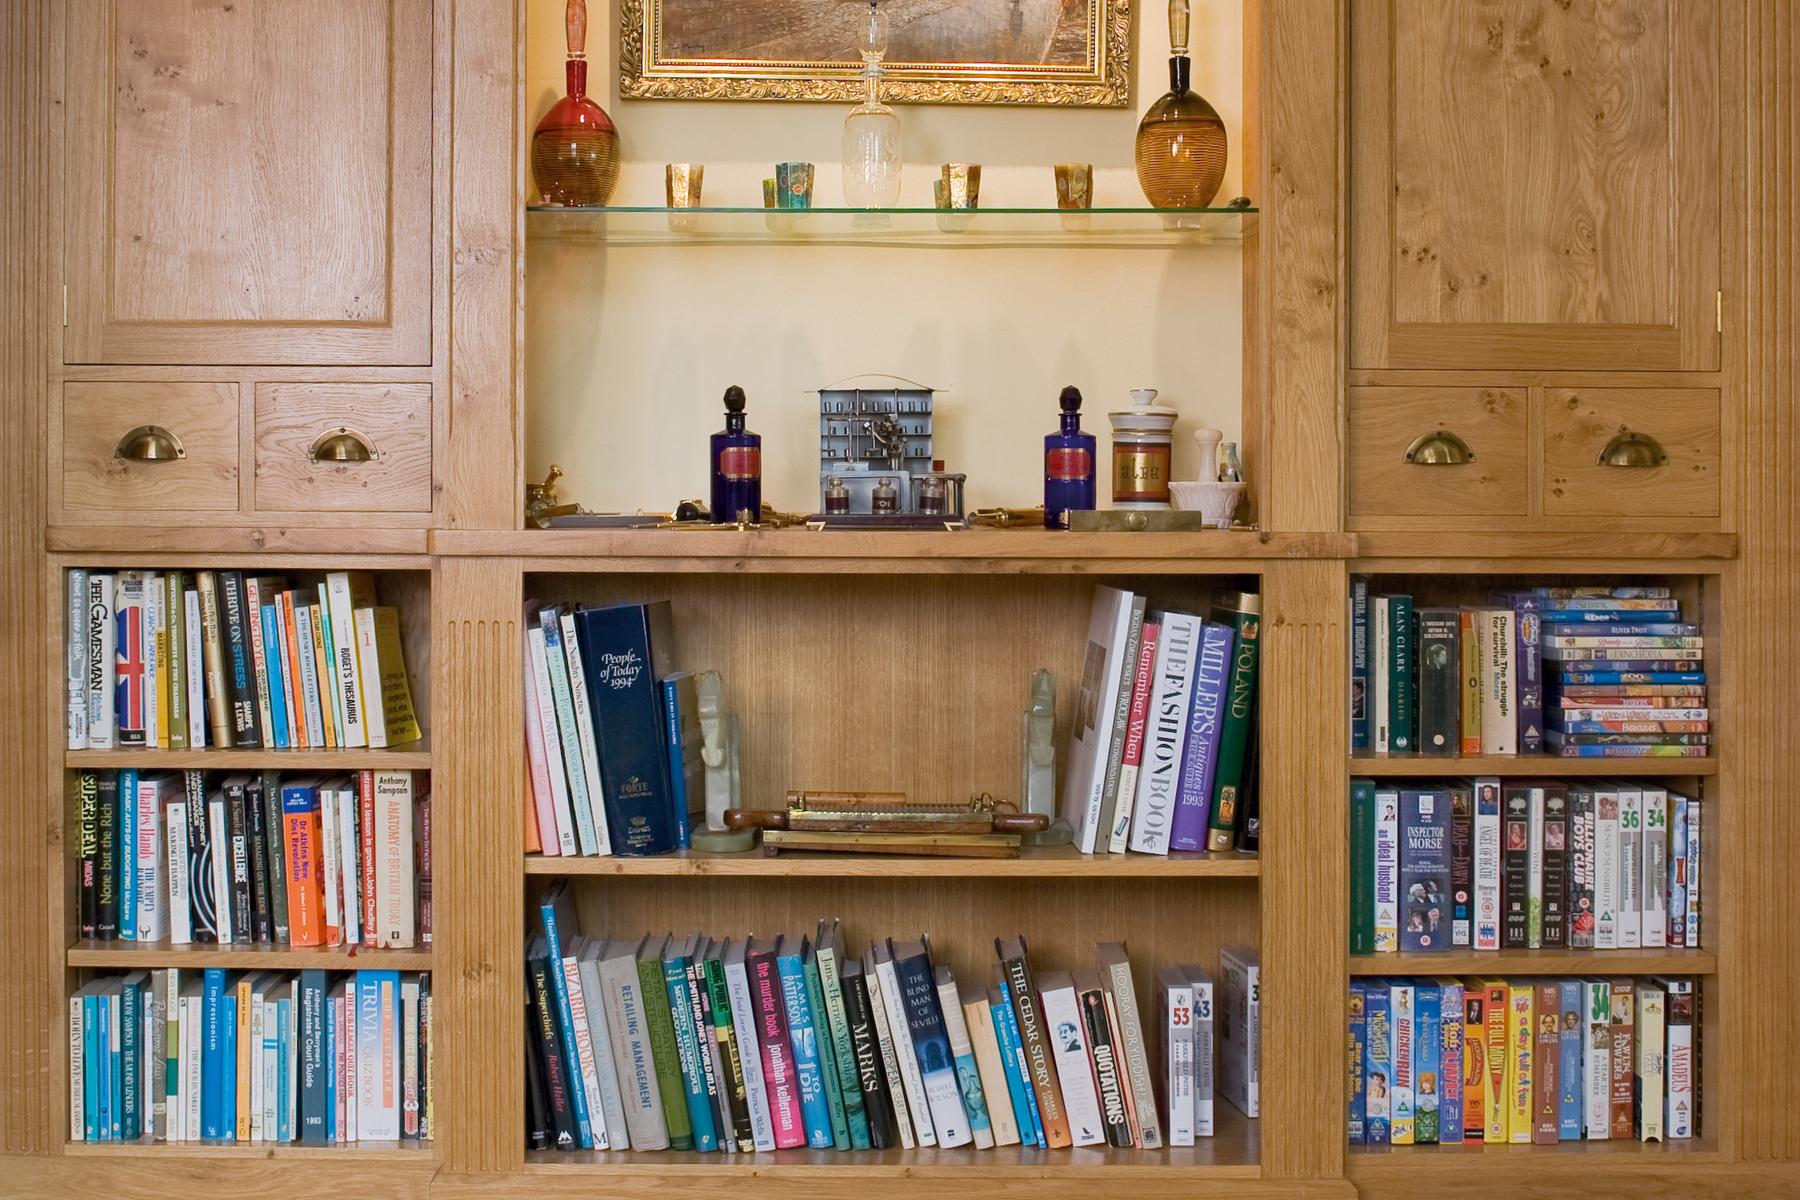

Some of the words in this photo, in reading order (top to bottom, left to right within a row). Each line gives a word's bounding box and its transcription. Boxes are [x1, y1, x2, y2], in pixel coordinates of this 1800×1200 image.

[91, 580, 102, 603] THE
[226, 578, 238, 624] THRIVE
[249, 584, 262, 631] GETTING
[1396, 604, 1405, 632] ALAN
[231, 626, 242, 643] ON
[566, 629, 577, 645] The
[1492, 616, 1500, 632] for
[1500, 616, 1508, 658] Churchill:
[91, 604, 108, 691] GAMESMAN
[252, 632, 262, 647] TO
[1166, 622, 1192, 674] THE
[1492, 633, 1500, 667] survival
[1614, 649, 1664, 658] DINOTOPIA
[233, 644, 246, 689] STRESS
[254, 649, 264, 668] YES
[341, 647, 354, 678] ROGET'S
[568, 646, 581, 680] Naughty
[602, 649, 641, 664] People
[1396, 637, 1406, 672] CLARK
[1500, 660, 1508, 678] The
[600, 667, 610, 683] of
[610, 664, 642, 680] Today
[611, 677, 634, 690] 1994
[1132, 641, 1158, 717] Remember
[1192, 639, 1226, 736] MILLER'S
[1231, 644, 1252, 720] POLAND
[1492, 671, 1500, 700] Moran
[235, 702, 242, 710] &
[344, 682, 358, 724] THESAURUS
[573, 684, 586, 714] Nineties
[1397, 681, 1406, 721] DIARIES
[1499, 680, 1508, 717] struggle
[236, 711, 246, 732] LEWIS
[243, 700, 254, 729] SHARPE
[1151, 674, 1184, 776] FASHION
[1622, 724, 1656, 732] HERCULES
[1126, 720, 1144, 760] When
[1106, 738, 1122, 798] RECOMMENDATIONS
[1193, 736, 1210, 792] Antiques
[378, 786, 408, 796] Sampson
[379, 777, 408, 788] Anthony
[621, 782, 648, 793] FORTE
[81, 775, 96, 820] SUPER
[140, 787, 156, 825] Charles
[1143, 776, 1164, 848] BOOK
[1182, 795, 1204, 807] 1993
[101, 804, 112, 826] Rich
[291, 818, 299, 835] Diet
[300, 820, 308, 830] Dr
[388, 801, 400, 844] ANATOMY
[1622, 811, 1640, 828] 36
[1647, 810, 1665, 826] 34
[81, 820, 96, 858] DEAL
[102, 831, 112, 848] the
[139, 829, 156, 860] Handy
[300, 832, 308, 858] Atkins
[1378, 829, 1388, 838] an
[1408, 826, 1444, 838] INSPECTOR
[1408, 838, 1443, 850] MORSE
[1478, 825, 1492, 846] ANGEL
[1574, 816, 1584, 850] BOYS
[102, 852, 112, 870] but
[292, 838, 300, 882] Revolution
[389, 846, 399, 856] OF
[1378, 840, 1394, 862] ideal
[1478, 847, 1492, 856] OF
[1584, 811, 1594, 892] BILLIONAIRE
[84, 860, 93, 886] MIDAS
[145, 867, 156, 884] THE
[302, 861, 310, 880] New
[388, 858, 400, 894] BRITAIN
[1452, 856, 1471, 885] DAWN
[1478, 857, 1492, 880] DEATH
[1574, 852, 1584, 884] CLUB
[101, 875, 112, 904] None
[1378, 864, 1394, 904] husband
[145, 886, 156, 912] EMPTY
[388, 898, 400, 926] TODAY
[1456, 930, 1468, 938] VHS
[536, 972, 546, 990] The
[710, 960, 723, 984] GOING
[757, 963, 768, 976] the
[909, 974, 924, 985] THE
[714, 985, 729, 1012] PUBLIC
[760, 979, 774, 1012] murder
[783, 976, 800, 1026] PATTERSON
[796, 975, 810, 1023] JAMES
[907, 984, 930, 996] BLIND
[910, 994, 932, 1006] MAN
[1114, 967, 1132, 1018] HOORAY
[210, 986, 218, 1050] Impressionism
[304, 988, 314, 1036] Magistrates'
[363, 982, 378, 1042] TRIVIA
[538, 990, 554, 1040] Superchiefs
[564, 963, 584, 1020] BIZARRE
[576, 1031, 596, 1080] BOOKS
[622, 986, 639, 1035] RETAILING
[640, 964, 652, 994] AND
[646, 998, 667, 1080] STRUCTURE
[650, 960, 662, 1000] RETAIL
[658, 1008, 676, 1078] STRATEGY
[820, 957, 836, 988] James
[830, 988, 844, 1030] Herriot's
[838, 1032, 854, 1083] Yorkshire
[918, 1008, 929, 1016] OF
[1173, 1008, 1190, 1026] 53
[1193, 1000, 1210, 1018] 43
[1488, 1008, 1504, 1024] THE
[1520, 1017, 1528, 1026] a
[153, 1001, 166, 1054] Parkinson's
[674, 985, 688, 1030] MODERN
[682, 1034, 698, 1094] HUMOROUS
[766, 1015, 779, 1038] book
[1010, 962, 1027, 994] THE
[1019, 996, 1039, 1042] CEDAR
[1032, 1044, 1051, 1088] STORY
[1124, 1021, 1138, 1045] FOR
[1398, 1018, 1411, 1059] CHICKEN
[1488, 1024, 1504, 1044] FULL
[1517, 1028, 1530, 1050] day
[306, 1038, 314, 1062] Court
[314, 1031, 322, 1068] Berryman's
[770, 1044, 786, 1084] jonathan
[852, 1020, 878, 1092] MARKS
[880, 1036, 900, 1086] WINESPEAK
[1488, 1046, 1504, 1074] MONTY
[1518, 1051, 1530, 1071] full
[1613, 1033, 1622, 1080] TOWERS
[1622, 1032, 1632, 1073] FAWLTY
[154, 1056, 166, 1081] Law
[306, 1064, 314, 1088] Guide
[363, 1047, 374, 1106] QUIZBOOK
[548, 1055, 560, 1084] Robert
[629, 1040, 652, 1108] MANAGEMENT
[1129, 1048, 1146, 1096] YIDDISH!
[1396, 1060, 1410, 1088] RUN
[1444, 1052, 1458, 1100] LIVE!
[1518, 1072, 1530, 1086] of
[1672, 1044, 1692, 1093] AMADEUS
[800, 1073, 814, 1104] DIE
[812, 1075, 820, 1092] TO
[1094, 1044, 1124, 1125] QUOTATIONS
[1517, 1088, 1530, 1106] fun
[552, 1086, 566, 1114] Heller
[777, 1085, 794, 1130] kellerman
[1046, 1090, 1058, 1120] CHARLES
